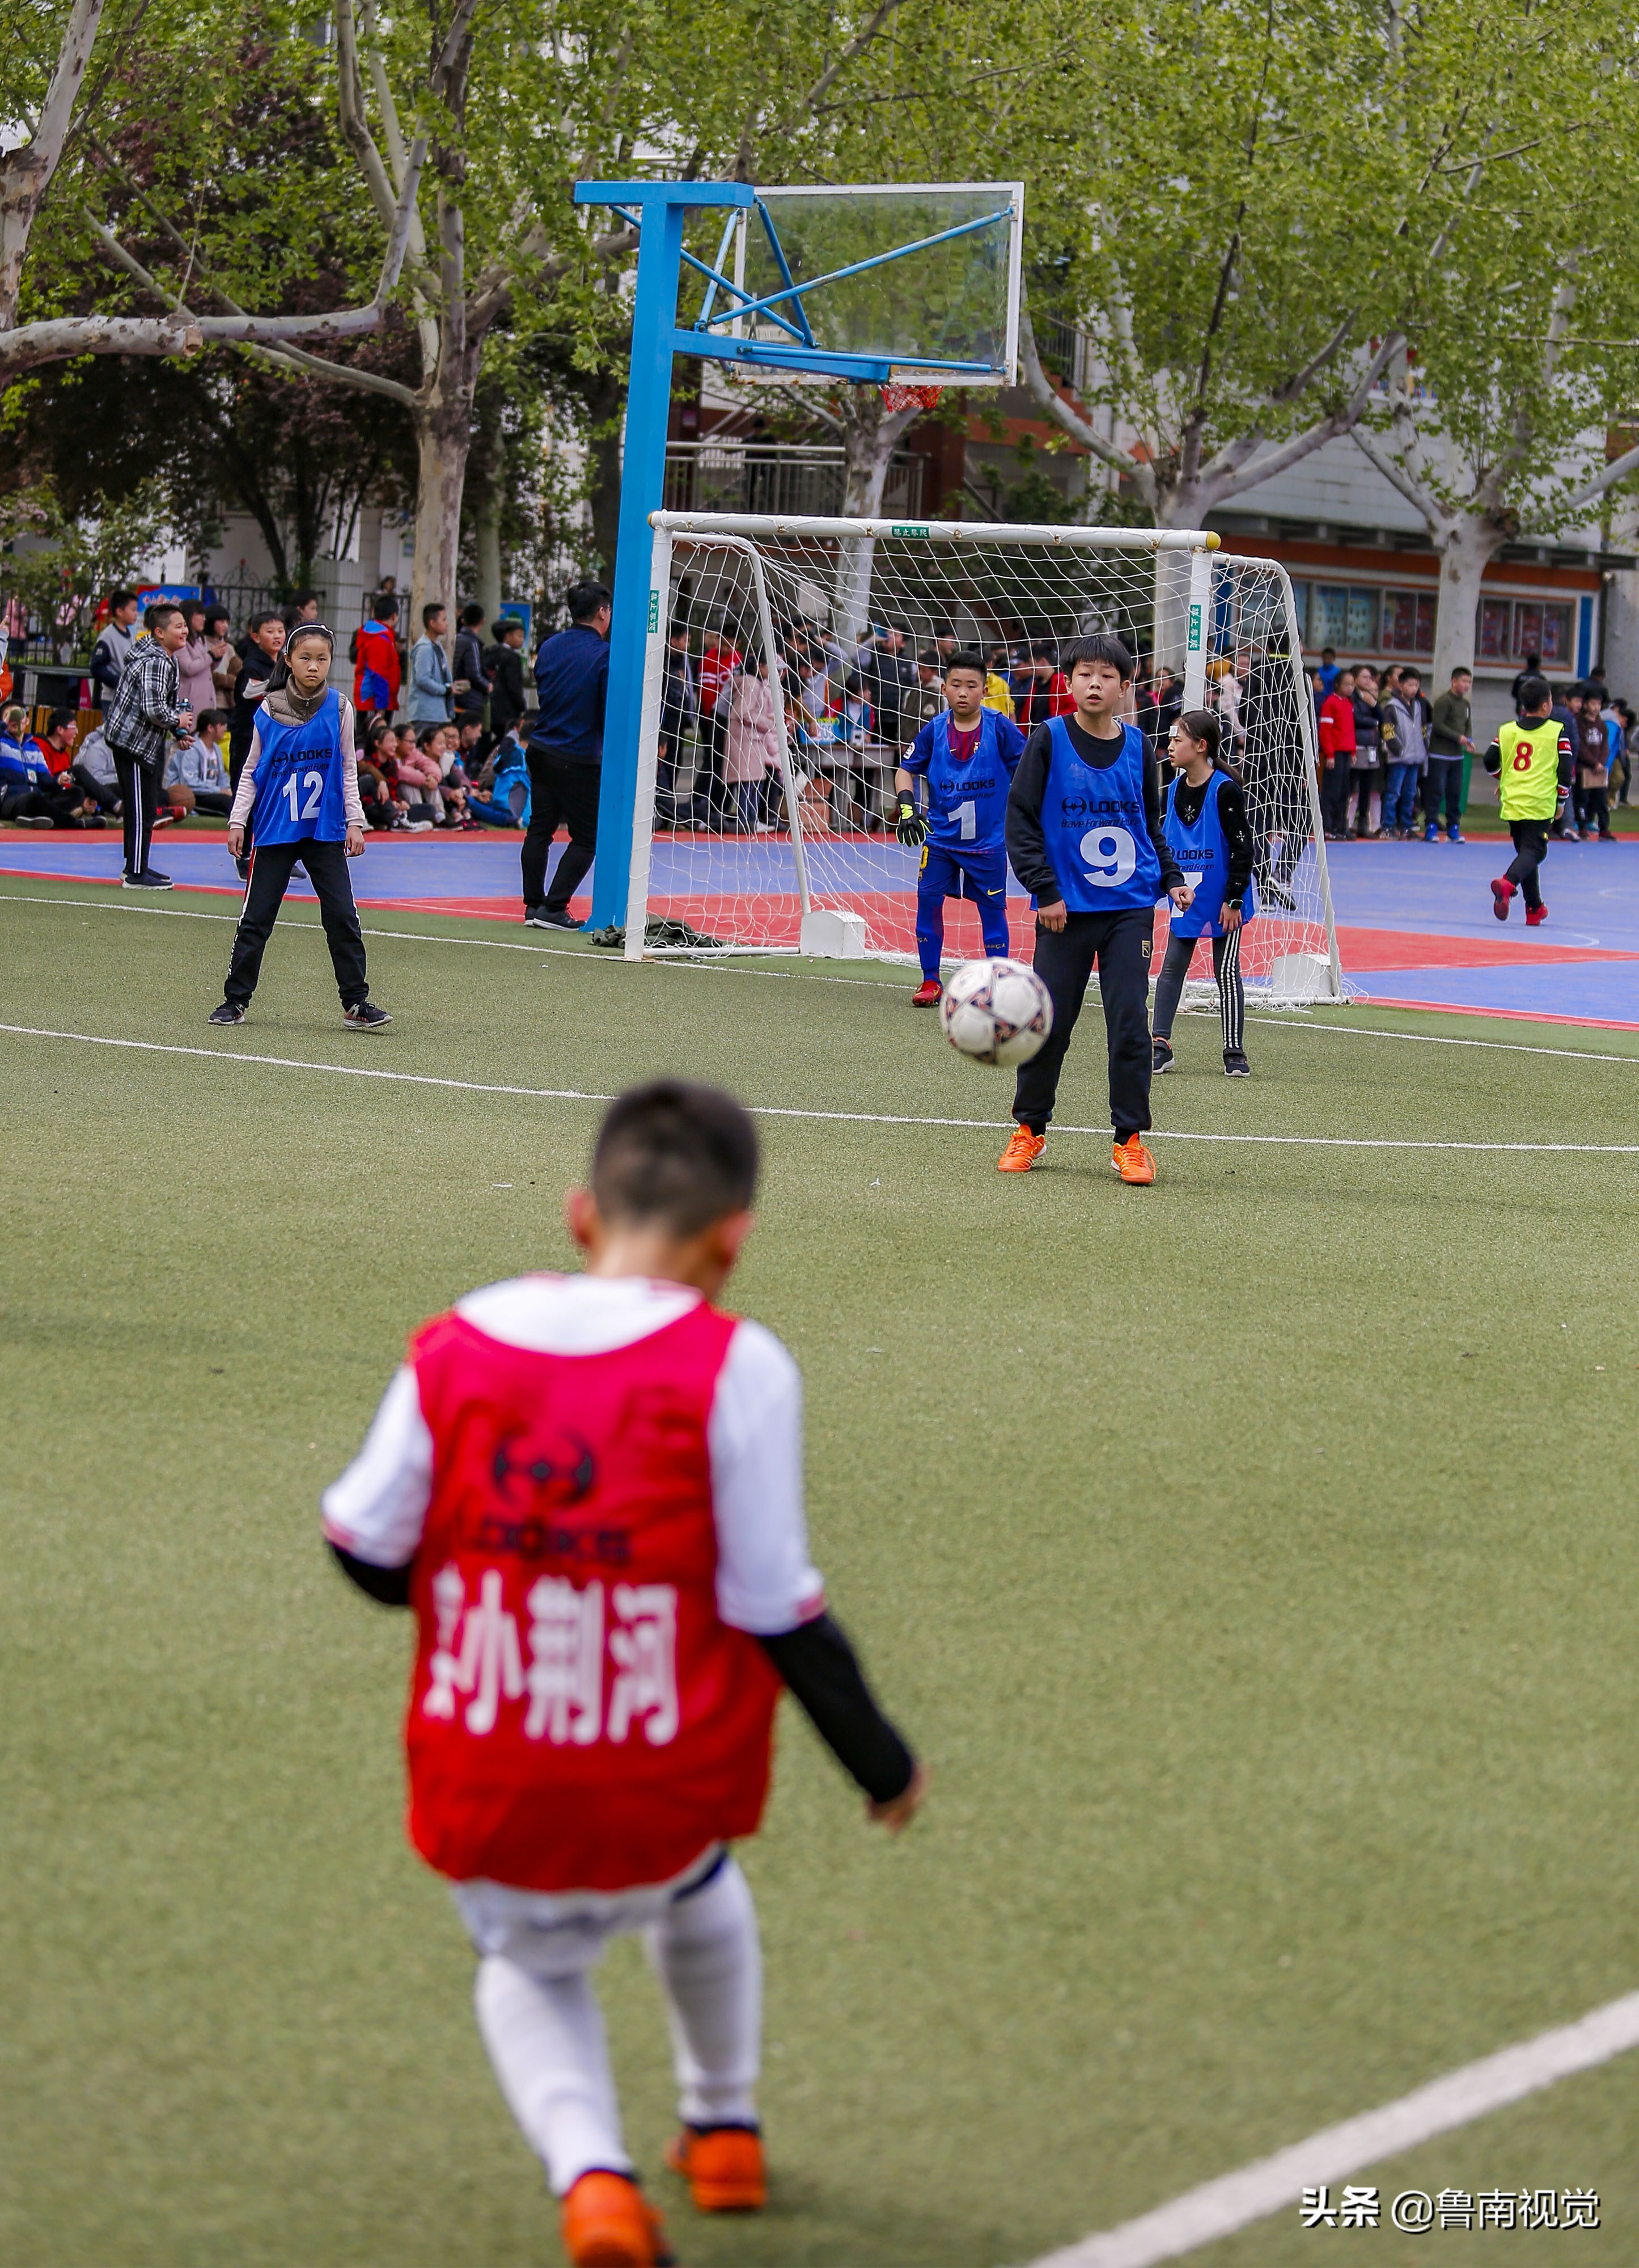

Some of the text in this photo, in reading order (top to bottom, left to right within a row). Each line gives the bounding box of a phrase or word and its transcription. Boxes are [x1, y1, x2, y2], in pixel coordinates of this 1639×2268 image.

[894, 528, 928, 537] 禁止攀爬
[1189, 607, 1199, 649] 禁止攀爬
[290, 748, 332, 762] LOOKS
[1513, 742, 1533, 771] 8
[956, 779, 995, 792] LOOKS
[282, 771, 323, 822] 12
[1089, 800, 1141, 814] LOOKS
[947, 800, 976, 840] 1
[1061, 819, 1084, 828] Brave
[1085, 817, 1121, 828] Forward
[1080, 826, 1136, 887] 9
[1176, 849, 1214, 860] LOOKS
